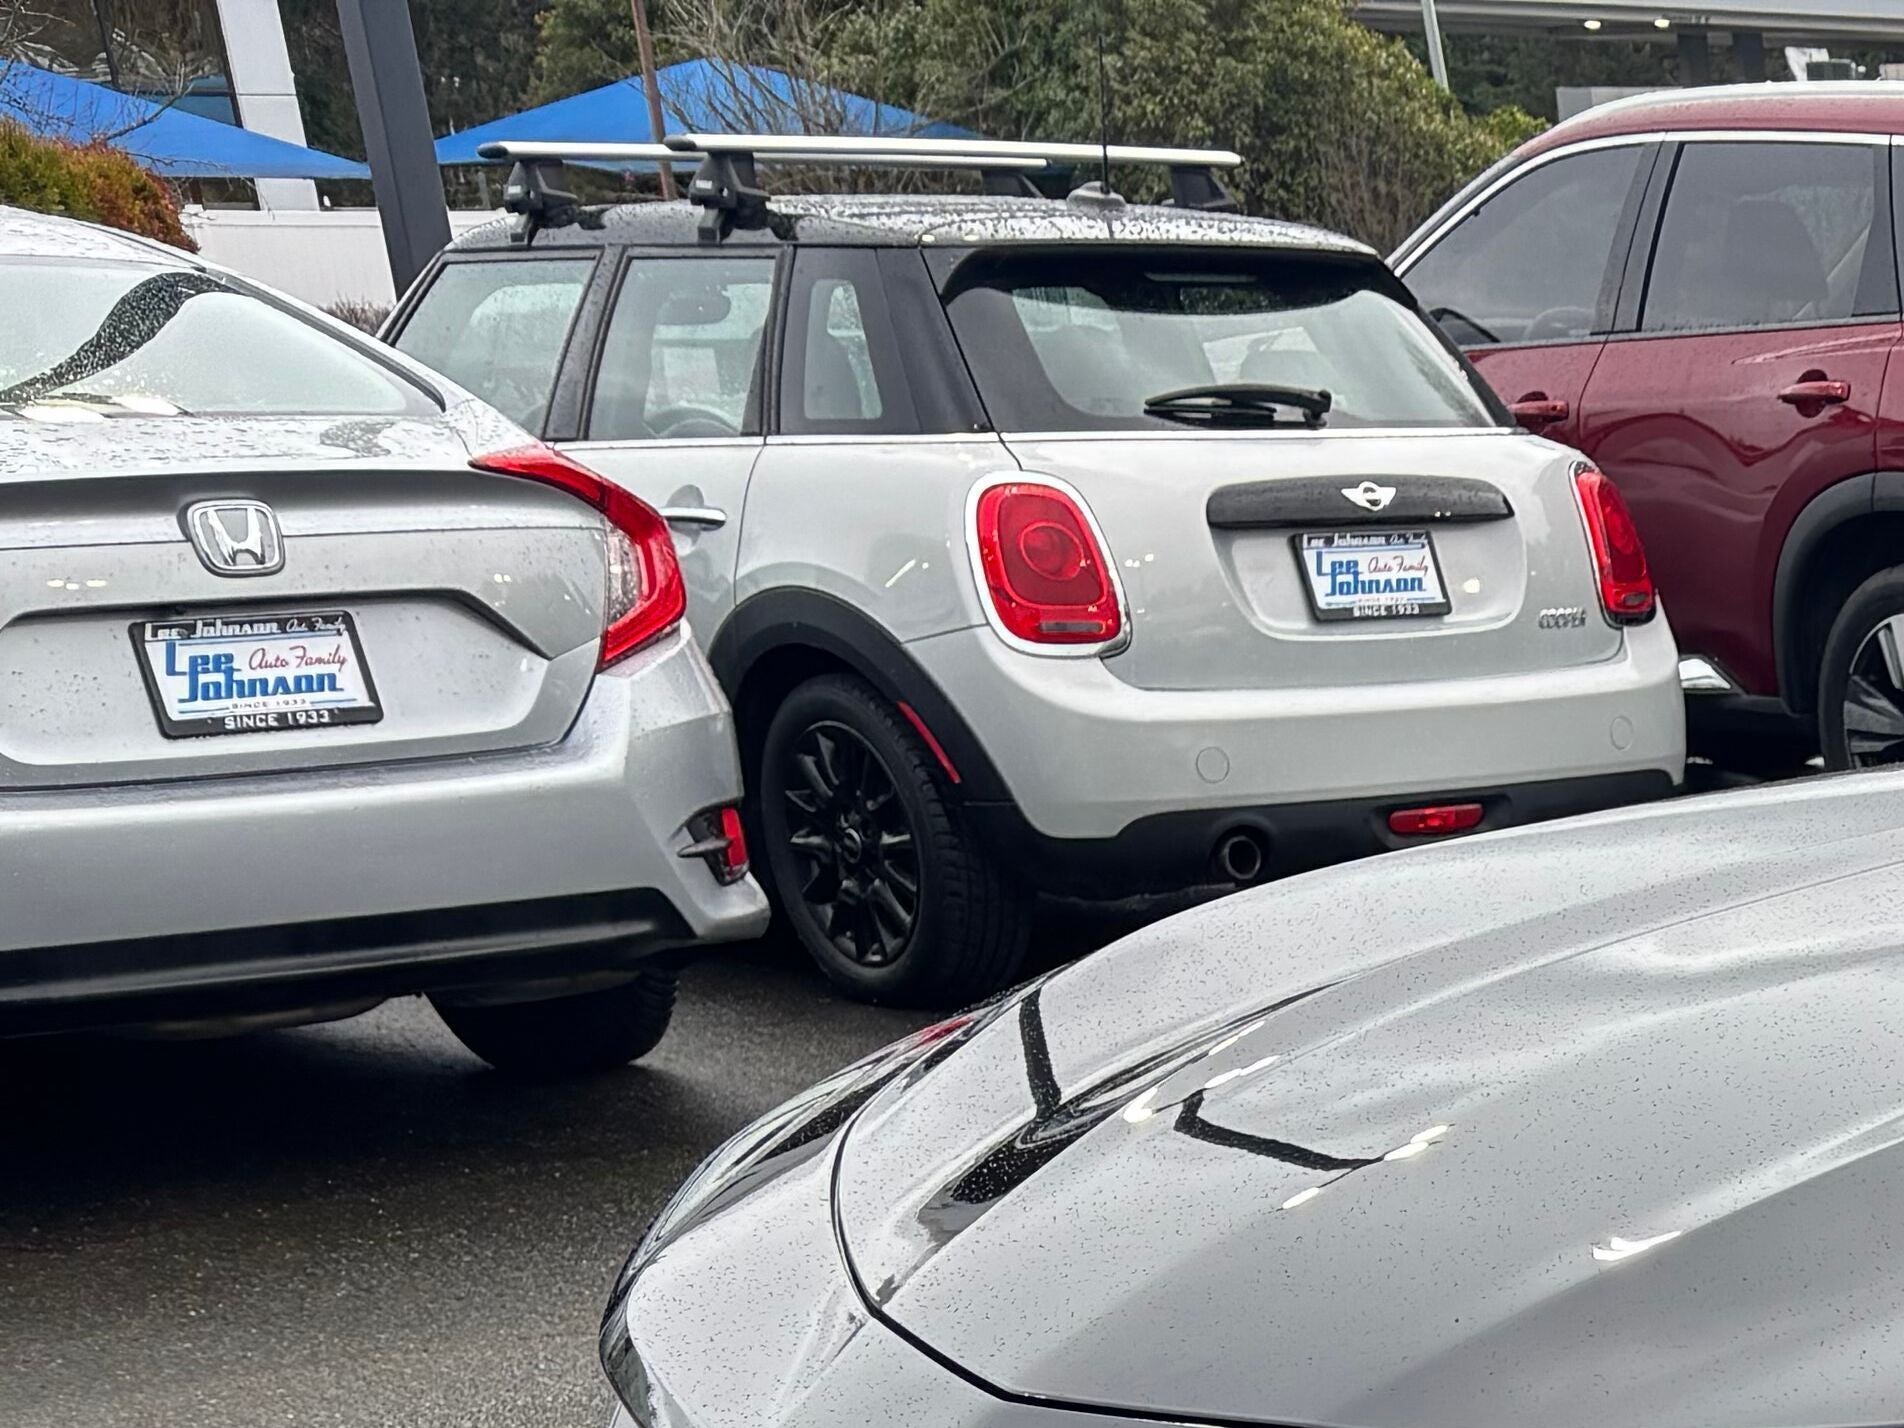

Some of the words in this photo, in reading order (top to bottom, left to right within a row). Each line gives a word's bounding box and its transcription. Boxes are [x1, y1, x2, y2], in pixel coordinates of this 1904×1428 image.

[1333, 533, 1387, 547] Johnson
[1316, 551, 1364, 576] Lee
[1368, 556, 1394, 574] Auto
[1394, 555, 1429, 576] Family
[1324, 571, 1427, 597] Johnson
[1353, 605, 1388, 617] SINCE
[190, 619, 282, 640] Johnson
[166, 641, 242, 676] Lee
[248, 648, 290, 671] Auto
[289, 644, 348, 672] Family
[178, 667, 344, 703] Johnson
[224, 714, 278, 729] SINCE
[288, 710, 330, 725] 1933
